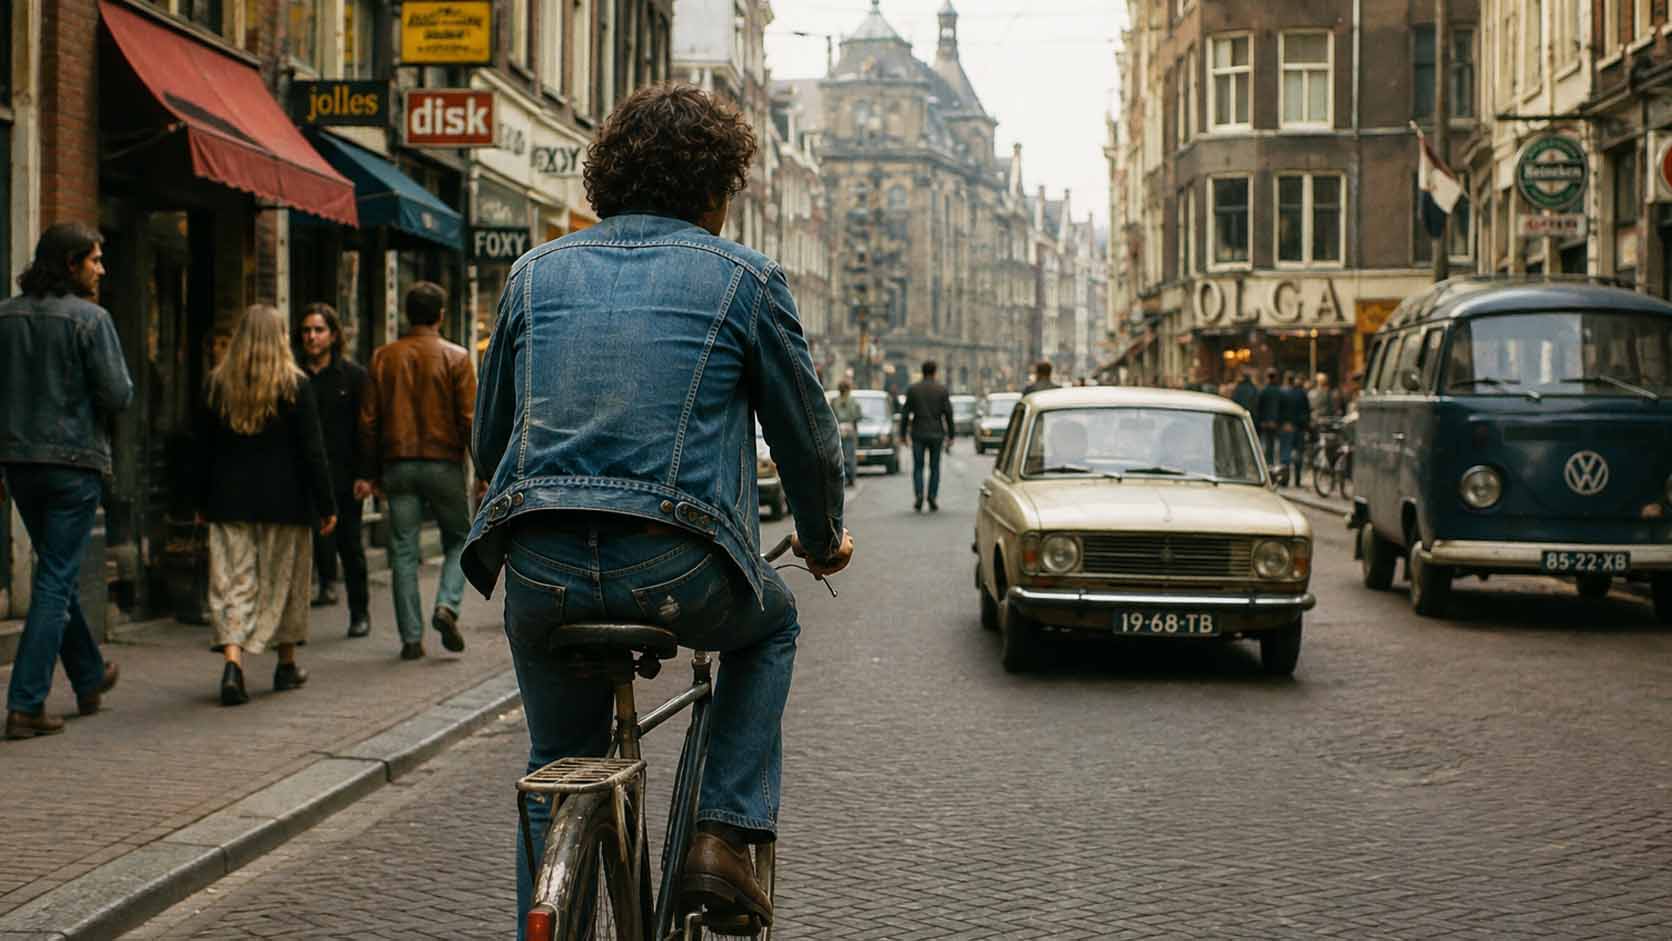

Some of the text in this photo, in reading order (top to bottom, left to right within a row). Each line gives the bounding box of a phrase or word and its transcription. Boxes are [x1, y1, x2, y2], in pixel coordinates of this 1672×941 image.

[307, 84, 379, 122] jolles
[411, 96, 489, 135] disk
[475, 231, 527, 257] FOXY
[1193, 278, 1345, 323] OLGA
[1546, 552, 1627, 571] 85-22-XB
[1122, 612, 1213, 634] 19-68-TB
